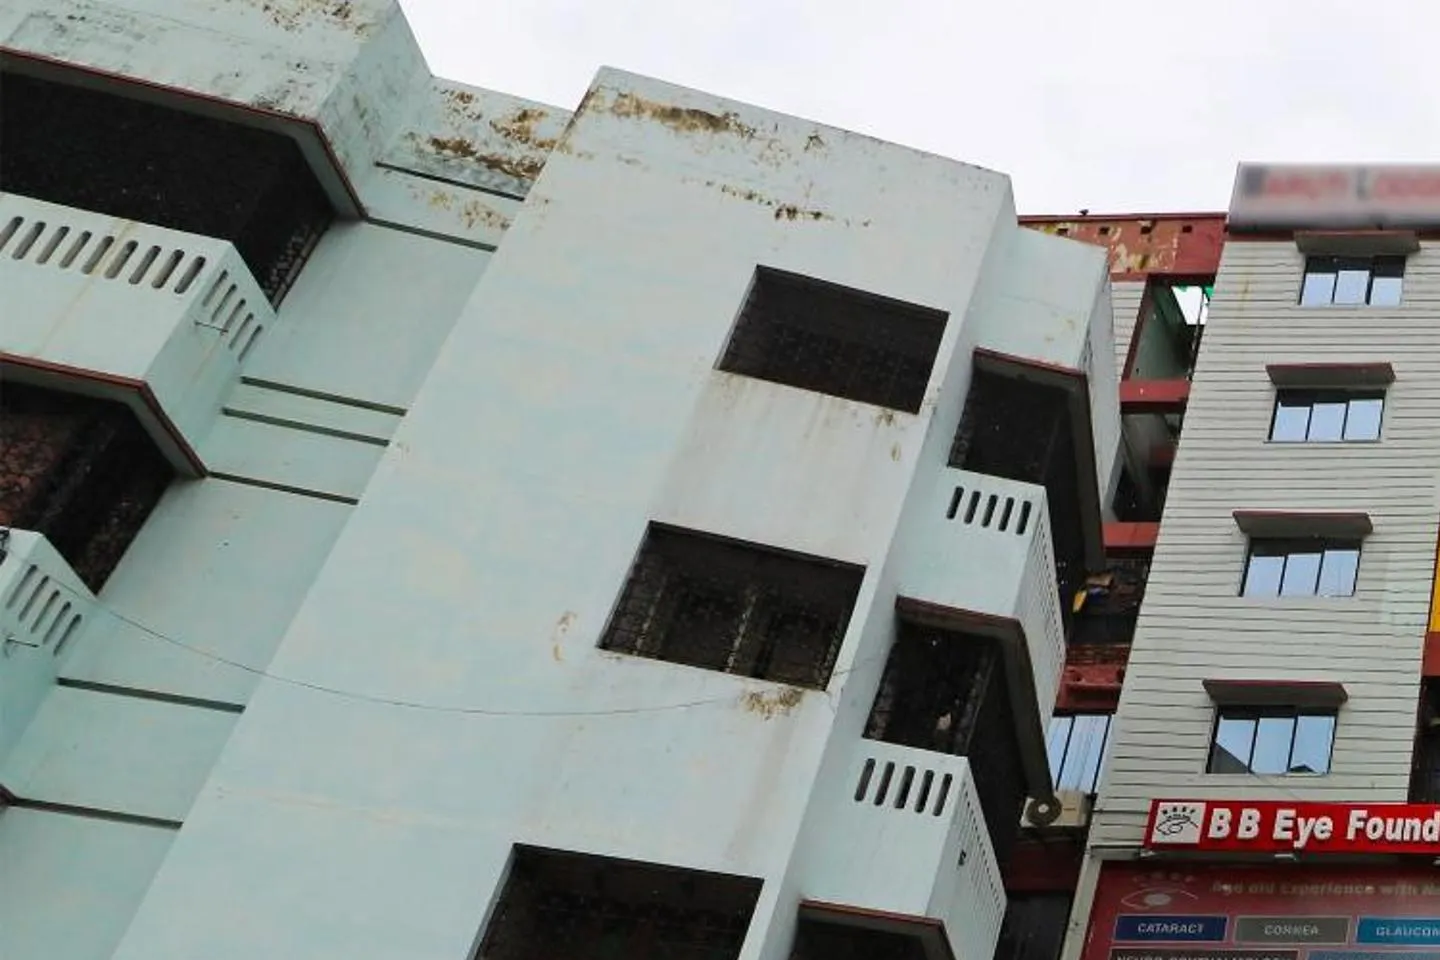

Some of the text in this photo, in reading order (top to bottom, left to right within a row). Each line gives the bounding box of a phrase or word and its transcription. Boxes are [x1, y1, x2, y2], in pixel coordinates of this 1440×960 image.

[1272, 809, 1334, 849] Eye
[1137, 922, 1205, 935] CATARACT
[1263, 924, 1320, 936] CORNEA
